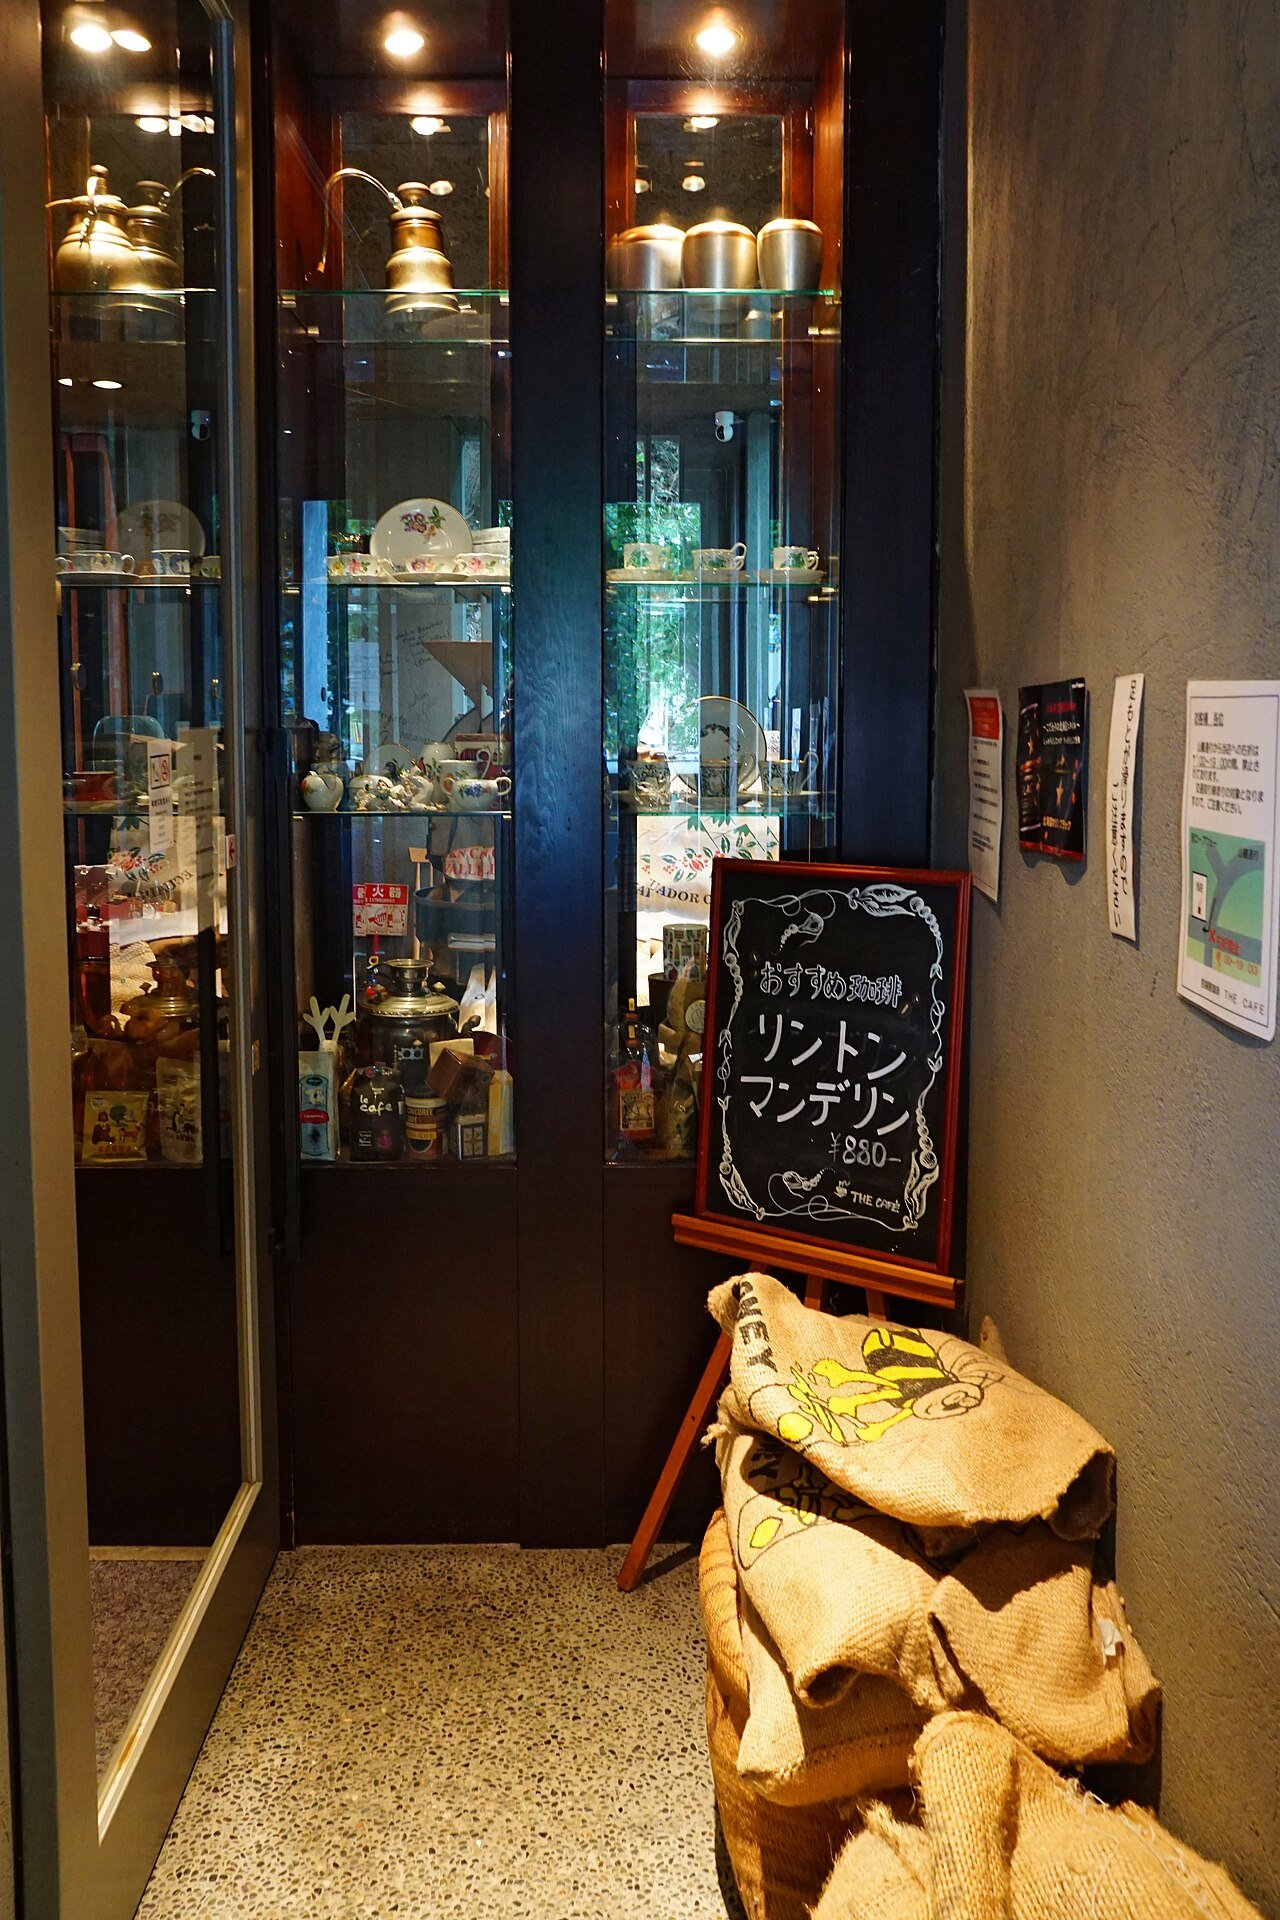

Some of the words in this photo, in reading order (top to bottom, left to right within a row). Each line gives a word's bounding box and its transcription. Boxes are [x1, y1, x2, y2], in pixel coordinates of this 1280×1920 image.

[759, 961, 904, 1009] おすすめ珈琲
[1224, 989, 1238, 1005] THE
[1242, 998, 1266, 1016] CAFE
[757, 1013, 908, 1081] リントン
[740, 1075, 910, 1136] マンデリン
[850, 1190, 874, 1207] THE
